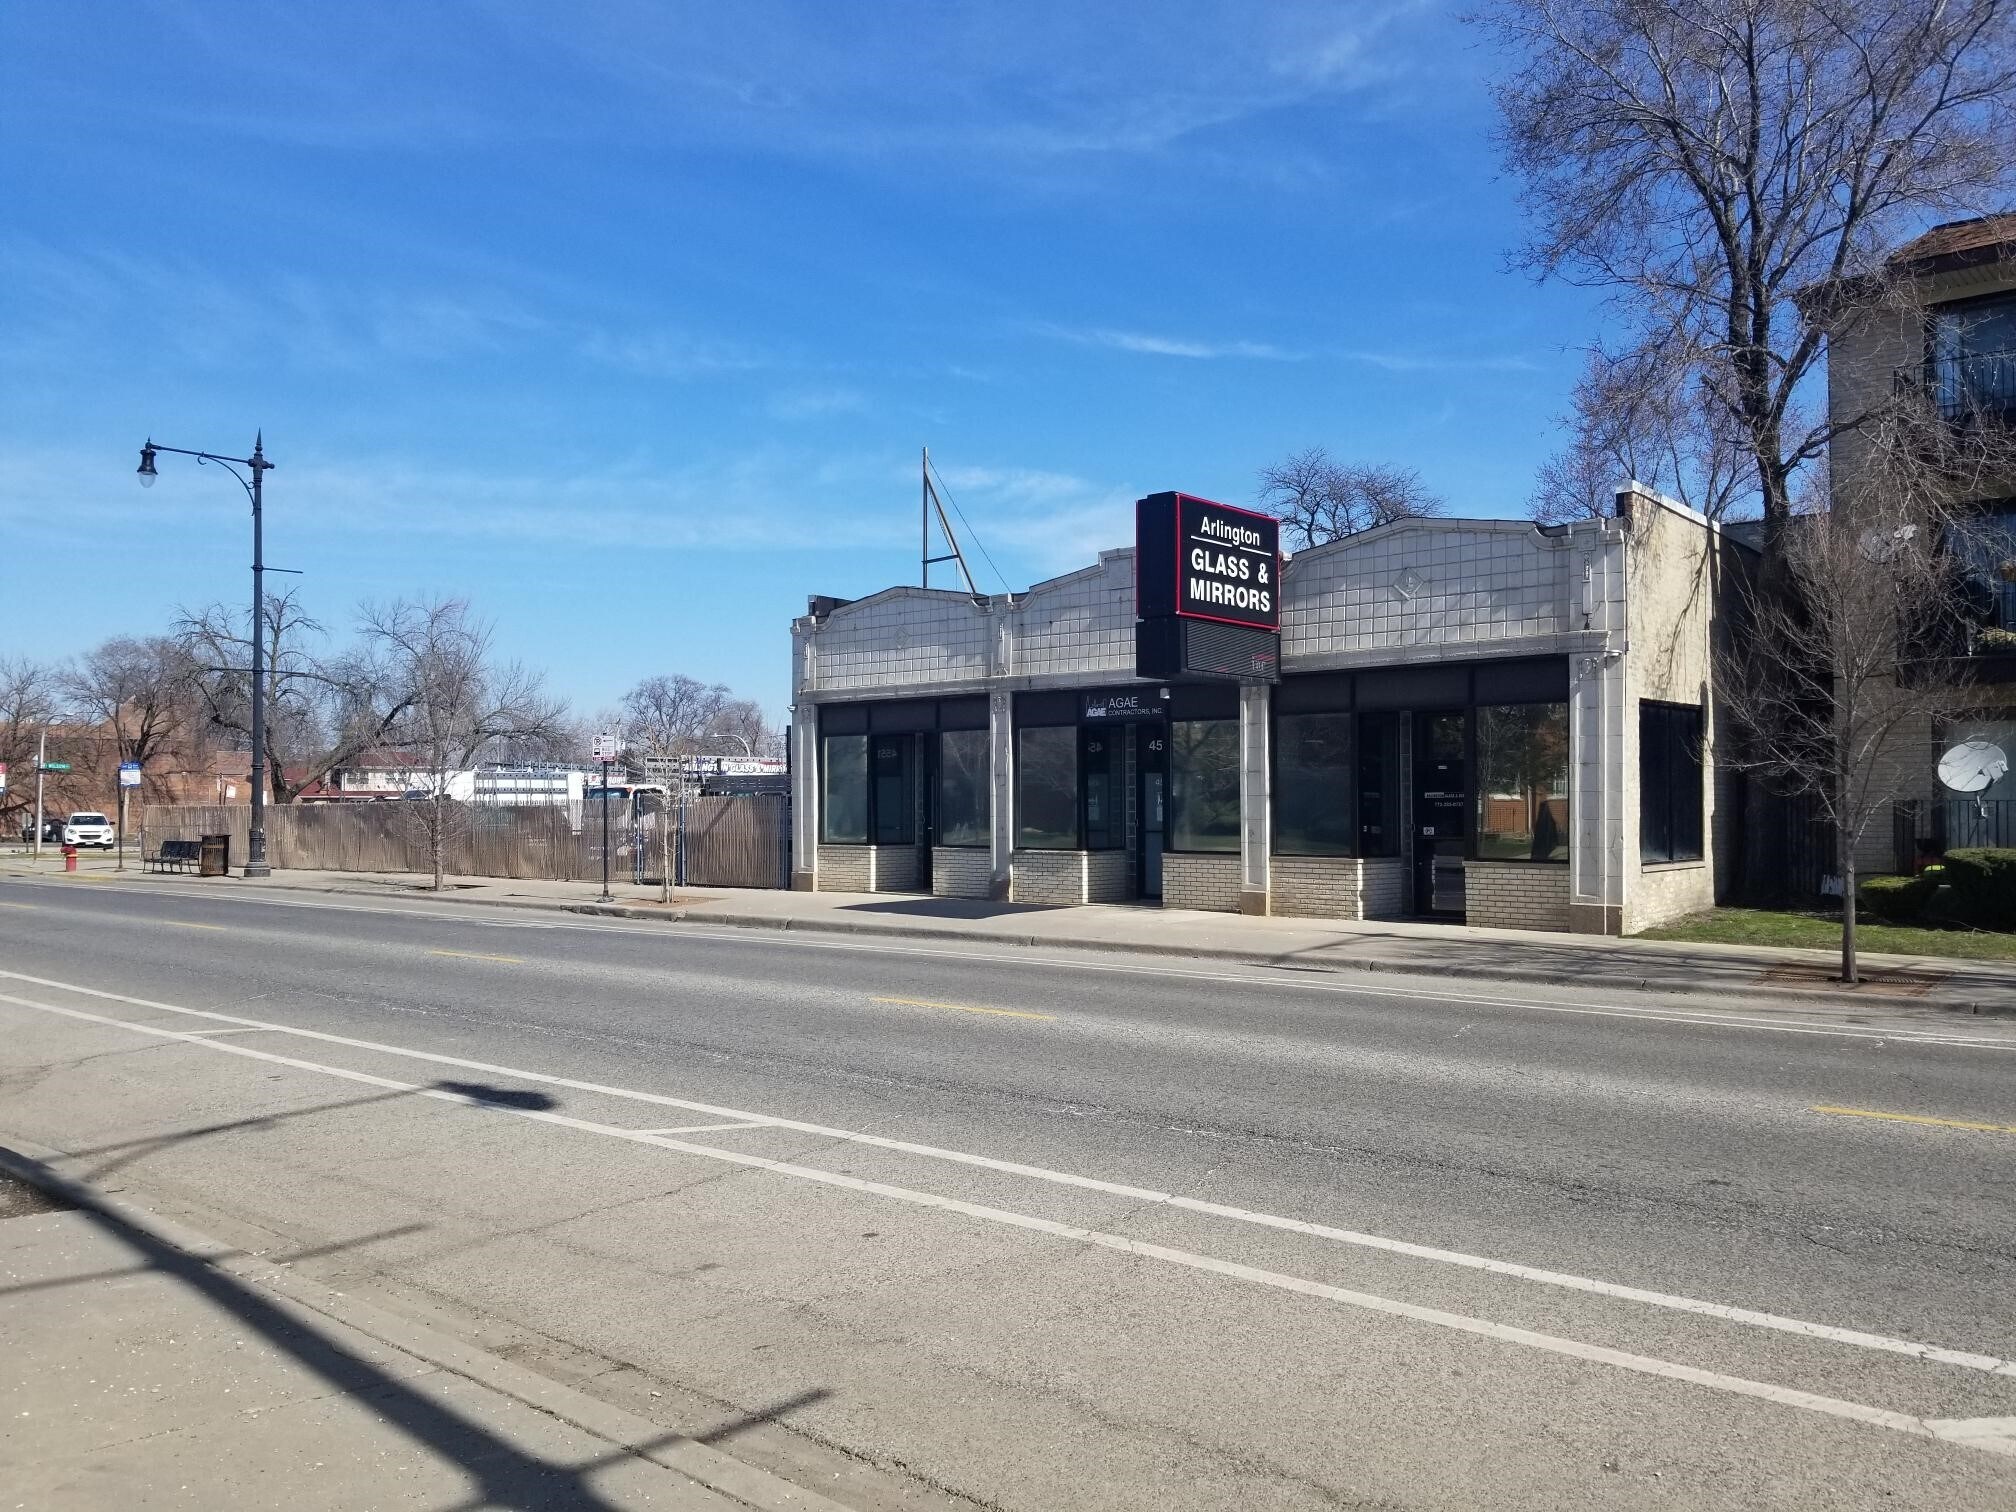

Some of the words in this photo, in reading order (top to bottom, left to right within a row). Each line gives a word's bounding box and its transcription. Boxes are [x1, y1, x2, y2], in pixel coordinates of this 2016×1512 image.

[1201, 516, 1260, 546] Arlington
[1191, 548, 1250, 580] GLASS
[1257, 562, 1270, 584] &
[1190, 577, 1271, 613] MIRRORS
[1109, 697, 1138, 708] AGAE
[1086, 707, 1107, 717] AGAE
[1149, 740, 1163, 751] 45
[683, 761, 728, 772] ALNGTN
[730, 763, 754, 773] GLASS
